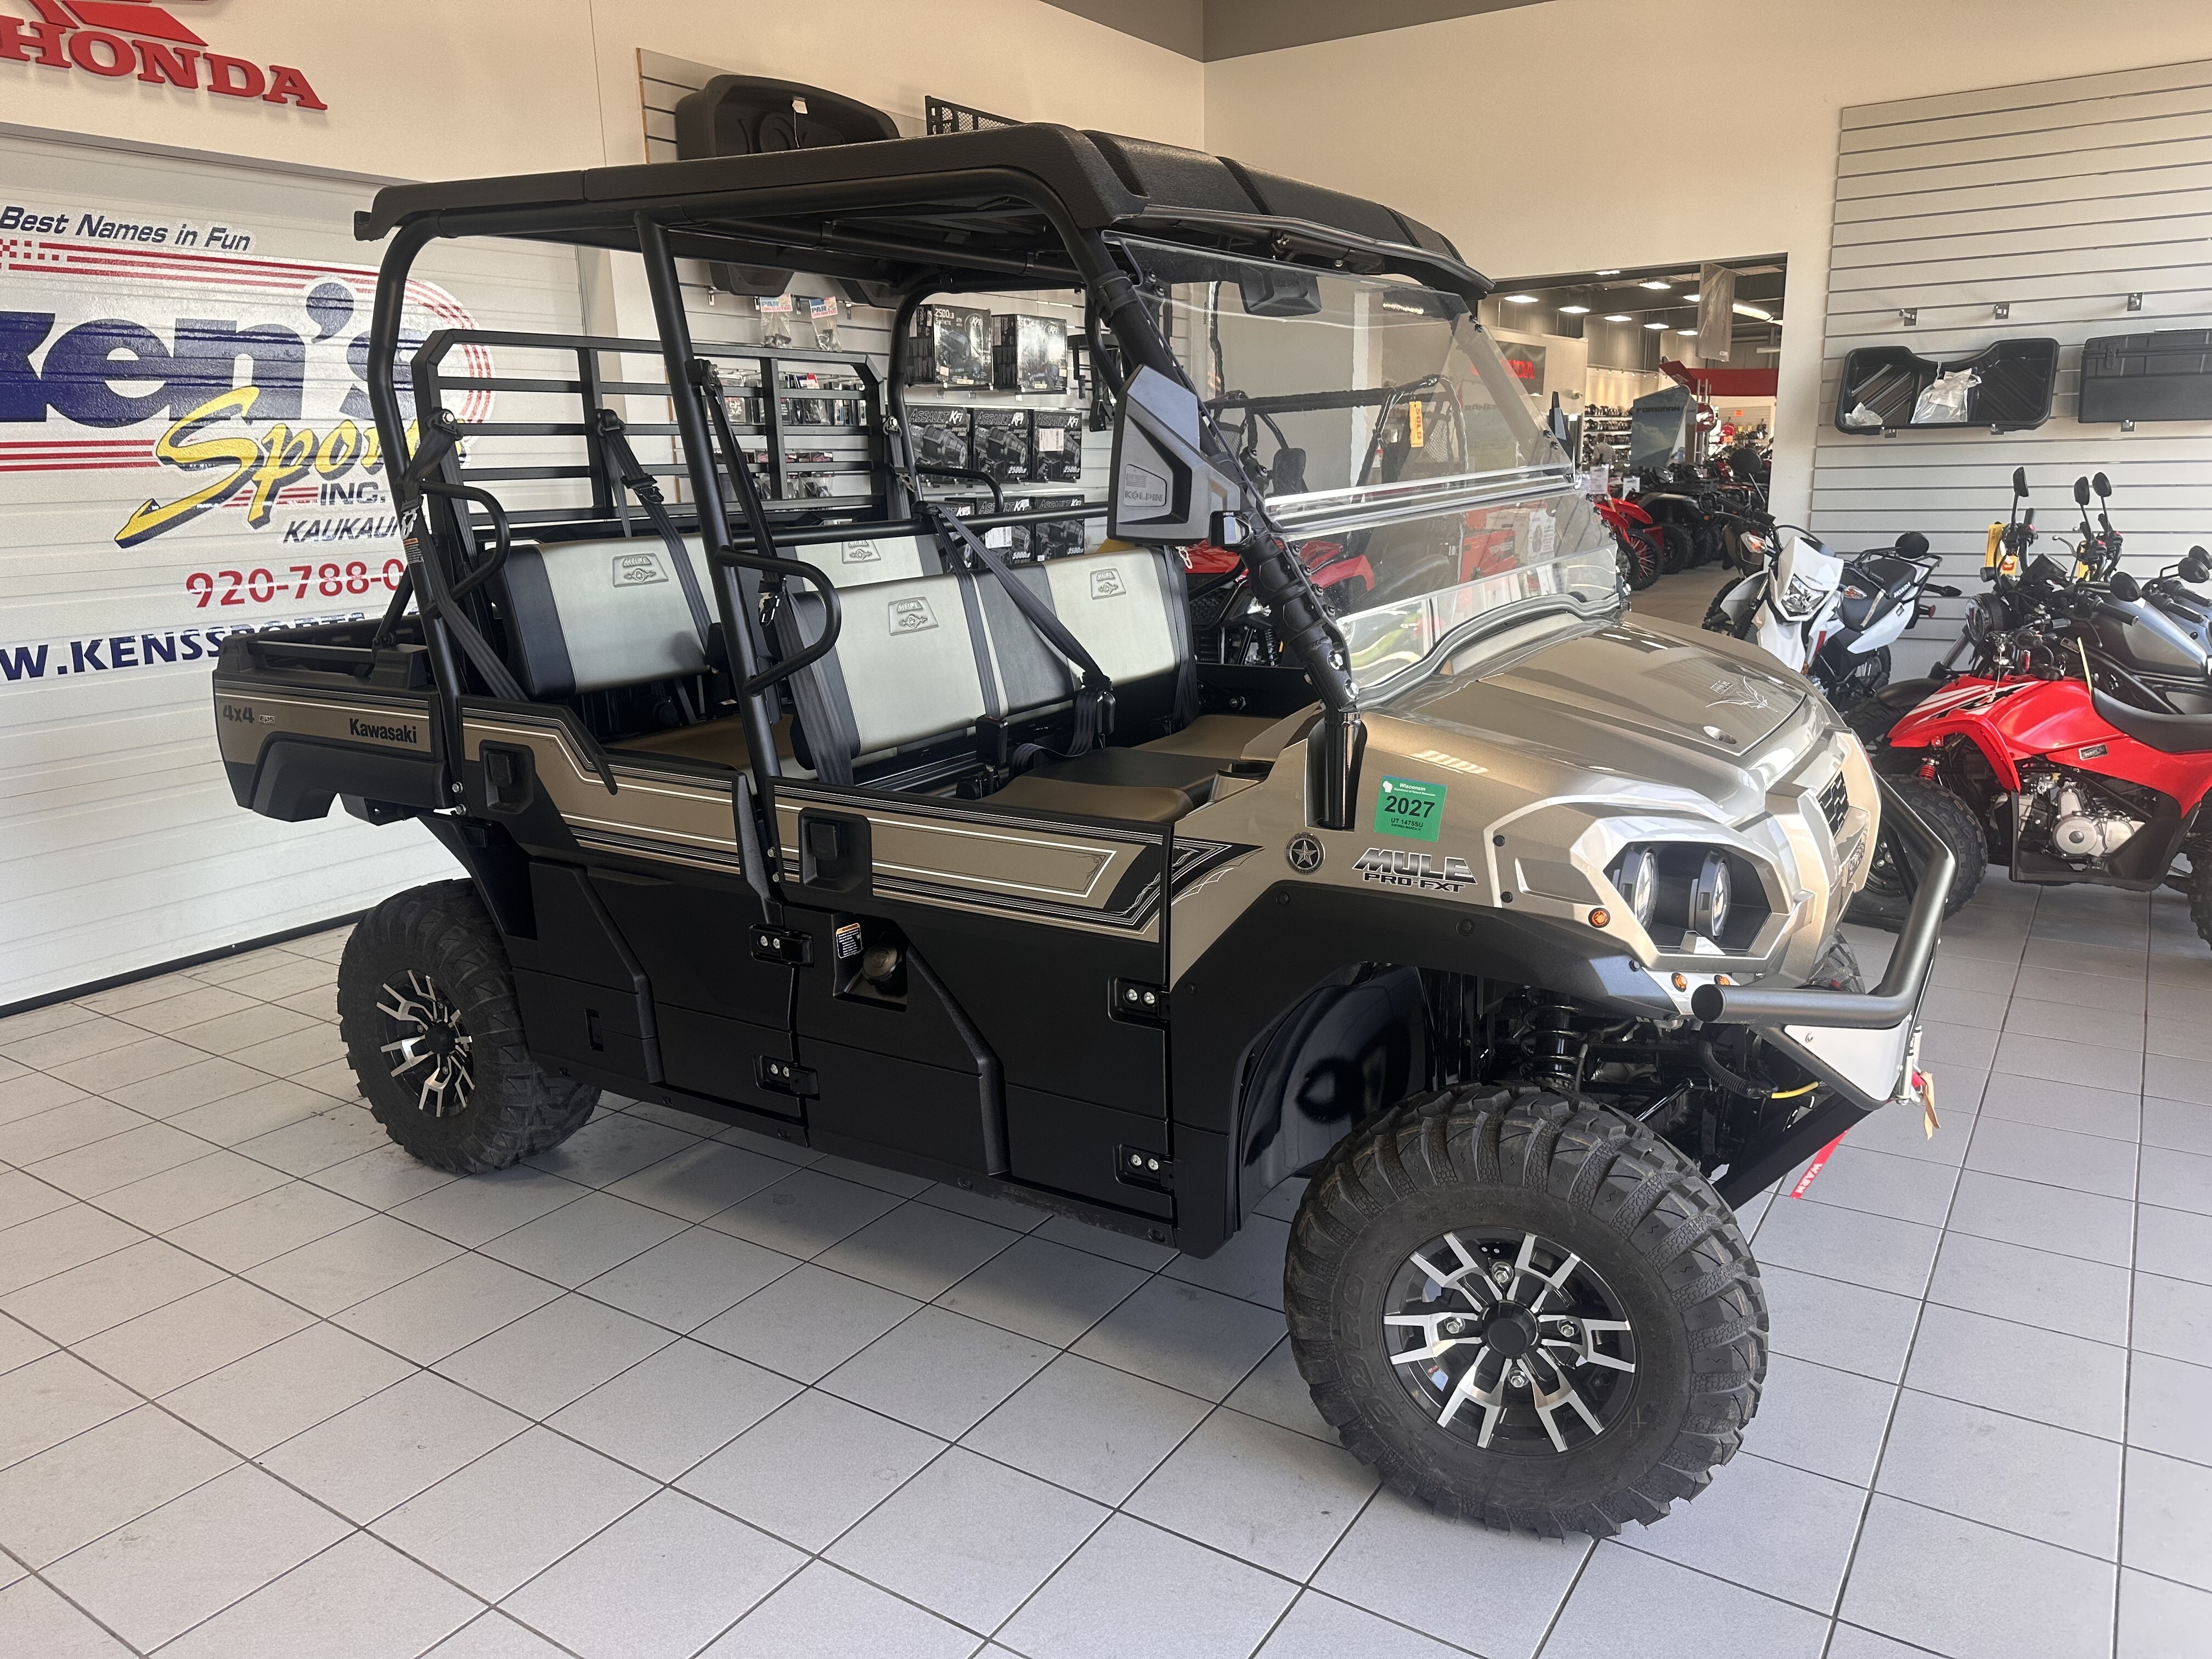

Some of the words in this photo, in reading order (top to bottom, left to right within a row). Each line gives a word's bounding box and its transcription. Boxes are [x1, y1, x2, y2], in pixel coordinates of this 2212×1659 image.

[0, 18, 328, 110] HONDA
[0, 206, 69, 234] Best
[75, 214, 168, 243] Names
[174, 224, 198, 245] in
[204, 227, 251, 251] Fun
[935, 308, 955, 319] 2500LB
[909, 409, 949, 423] ASSAULT
[975, 411, 1013, 425] ASSAULT
[1035, 413, 1068, 427] ASSAULT
[1008, 466, 1026, 475] 2500LB
[320, 482, 386, 506] INC.
[1125, 490, 1164, 502] KOLPIN
[623, 556, 652, 567] MULE
[1012, 551, 1030, 560] 5000LB
[186, 558, 404, 607] 920-788-0
[1097, 571, 1115, 582] MULE
[1893, 582, 1911, 599] HONDA
[897, 600, 923, 613] MULE
[222, 704, 255, 724] 4x4
[349, 718, 417, 744] Kawasaki
[1400, 783, 1426, 791] Wisconsin
[1384, 795, 1435, 819] 2027
[1401, 819, 1424, 828] 1475SU
[1352, 848, 1478, 885] MULE
[1363, 872, 1465, 893] PRO-FXT
[1795, 1163, 1823, 1194] WARN
